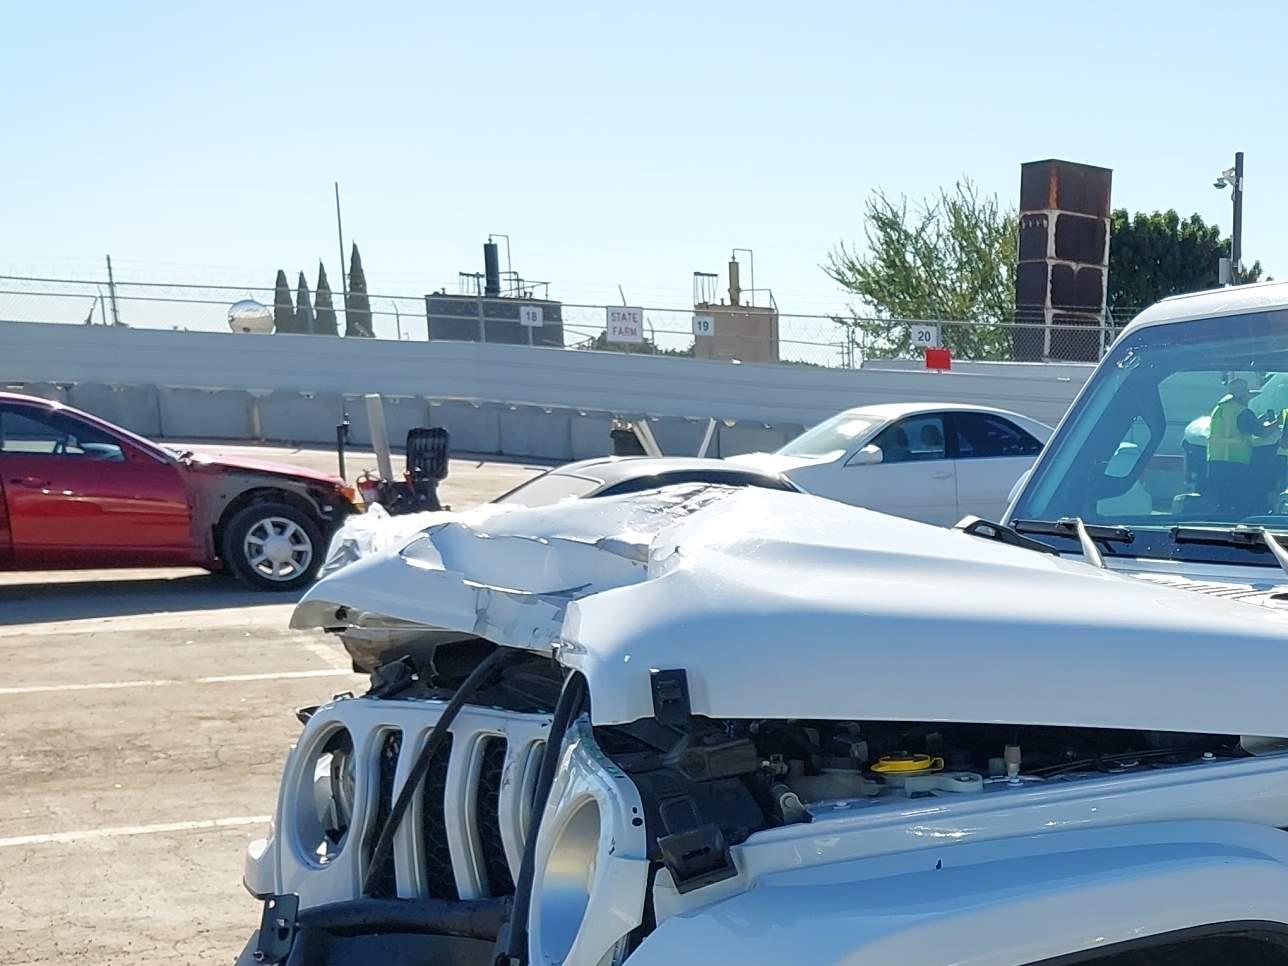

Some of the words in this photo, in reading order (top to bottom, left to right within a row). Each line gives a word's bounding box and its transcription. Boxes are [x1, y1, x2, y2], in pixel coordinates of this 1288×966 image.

[610, 311, 638, 323] STATE
[697, 320, 709, 331] 19
[612, 326, 638, 337] FARM
[918, 330, 931, 342] 20
